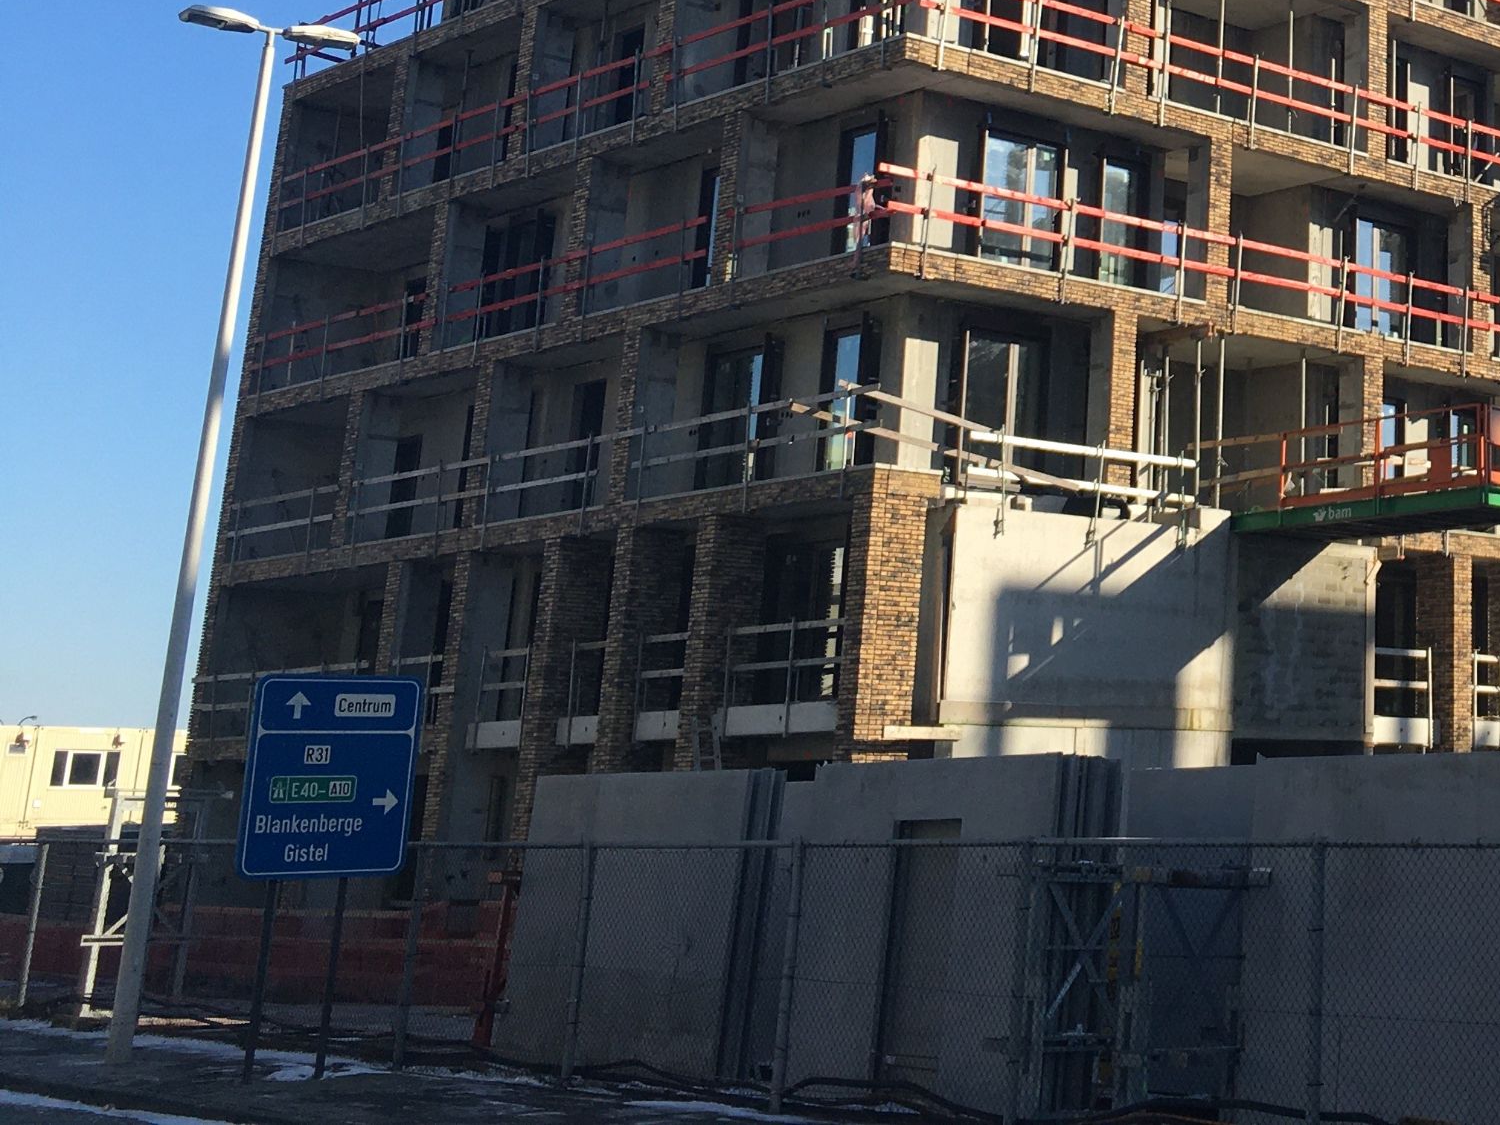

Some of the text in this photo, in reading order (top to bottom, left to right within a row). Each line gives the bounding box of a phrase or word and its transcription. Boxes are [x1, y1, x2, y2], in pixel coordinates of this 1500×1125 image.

[1328, 506, 1352, 520] bam
[338, 698, 392, 714] Centrum
[305, 747, 329, 763] R31
[330, 782, 350, 796] A10
[254, 814, 363, 837] Blankenberge
[284, 843, 329, 863] Gistel
